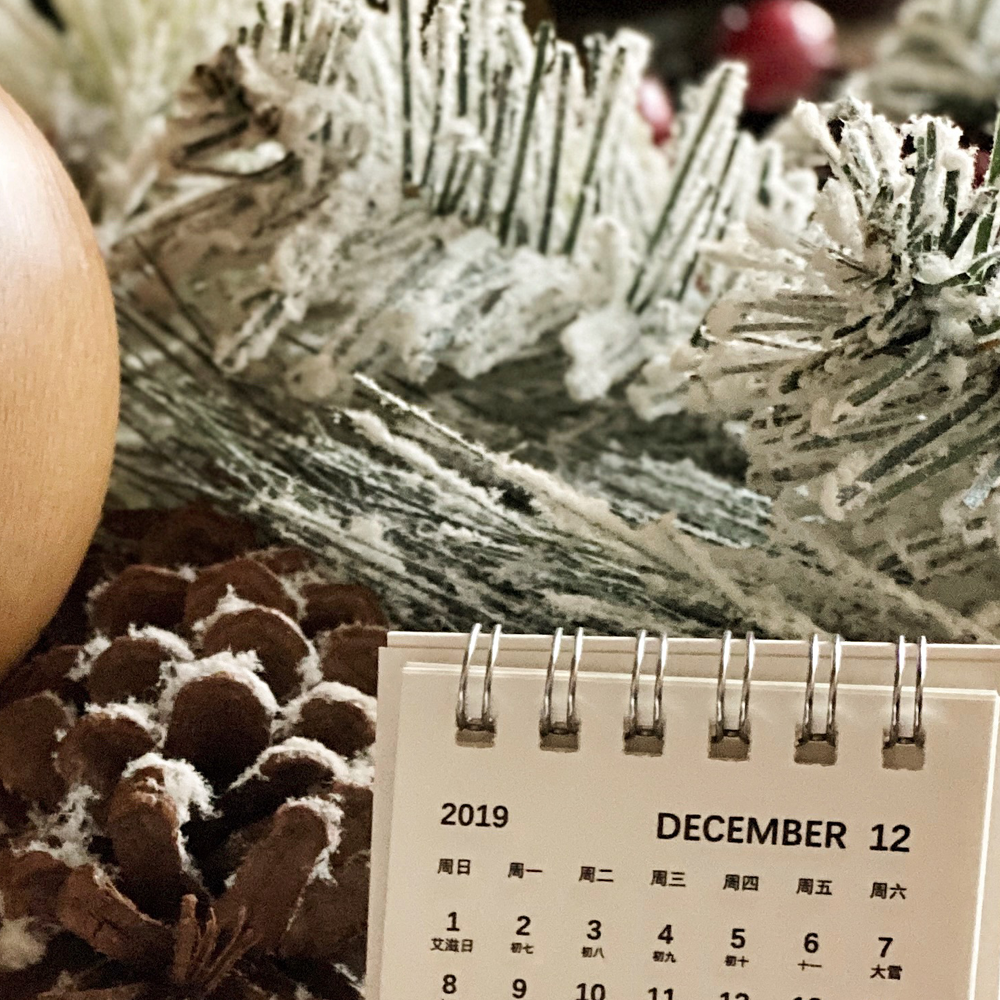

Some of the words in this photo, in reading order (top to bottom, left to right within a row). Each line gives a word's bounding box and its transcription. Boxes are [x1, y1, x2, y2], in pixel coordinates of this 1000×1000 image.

[441, 803, 508, 828] 2019
[657, 812, 847, 849] DECEMBER
[869, 824, 911, 852] 12
[437, 858, 471, 875] 周日
[508, 862, 543, 879] 周一
[579, 866, 614, 883] 周二
[650, 870, 686, 887] 周三
[723, 874, 759, 891] 周四
[796, 878, 832, 895] 周五
[870, 882, 907, 899] 周六
[446, 912, 460, 932] 1
[516, 915, 531, 936] 2
[587, 920, 601, 940] 3
[658, 924, 674, 944] 4
[730, 928, 746, 949] 5
[804, 933, 819, 953] 6
[878, 937, 893, 958] 7
[798, 960, 822, 971] 十一
[442, 974, 457, 994] 8
[512, 979, 527, 999] 9
